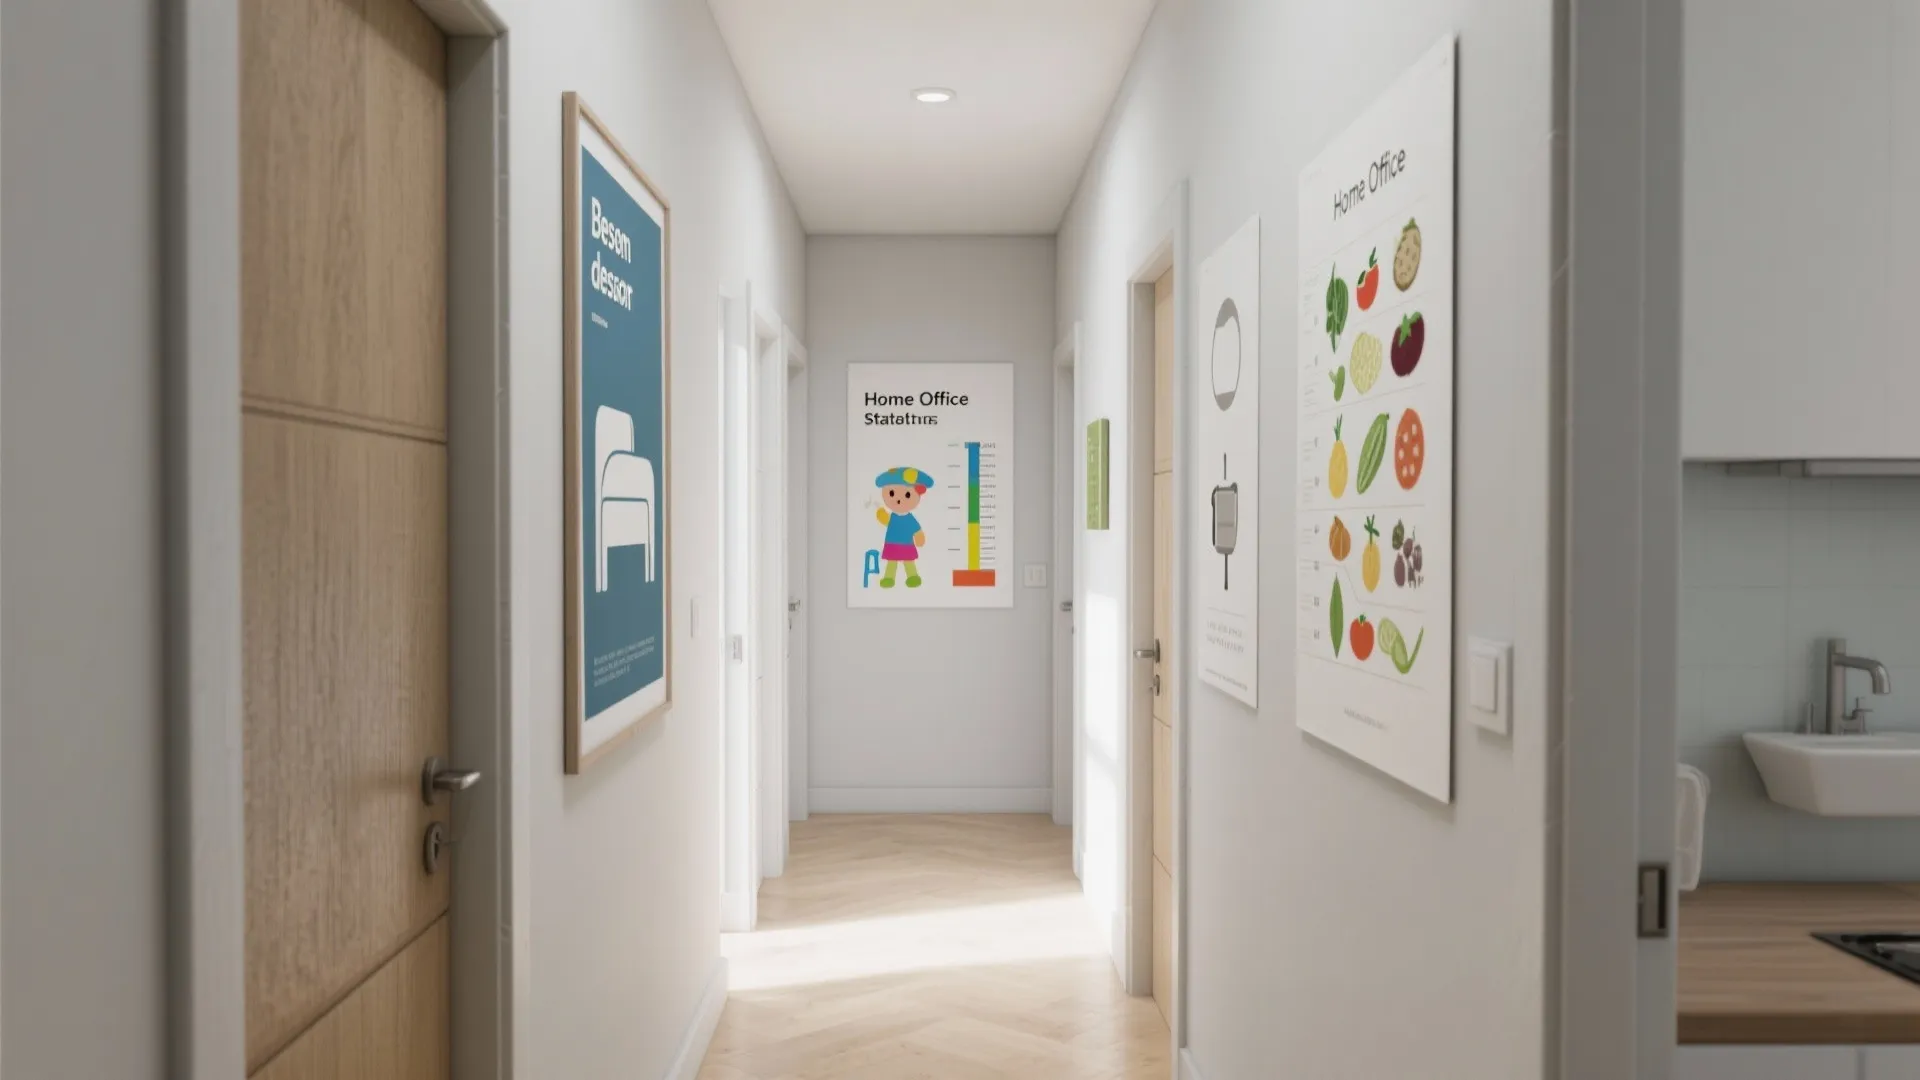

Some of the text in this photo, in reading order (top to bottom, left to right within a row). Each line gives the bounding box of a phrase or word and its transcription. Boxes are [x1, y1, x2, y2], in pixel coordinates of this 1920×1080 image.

[1333, 149, 1406, 221] Home Office
[864, 391, 969, 406] Home Office
